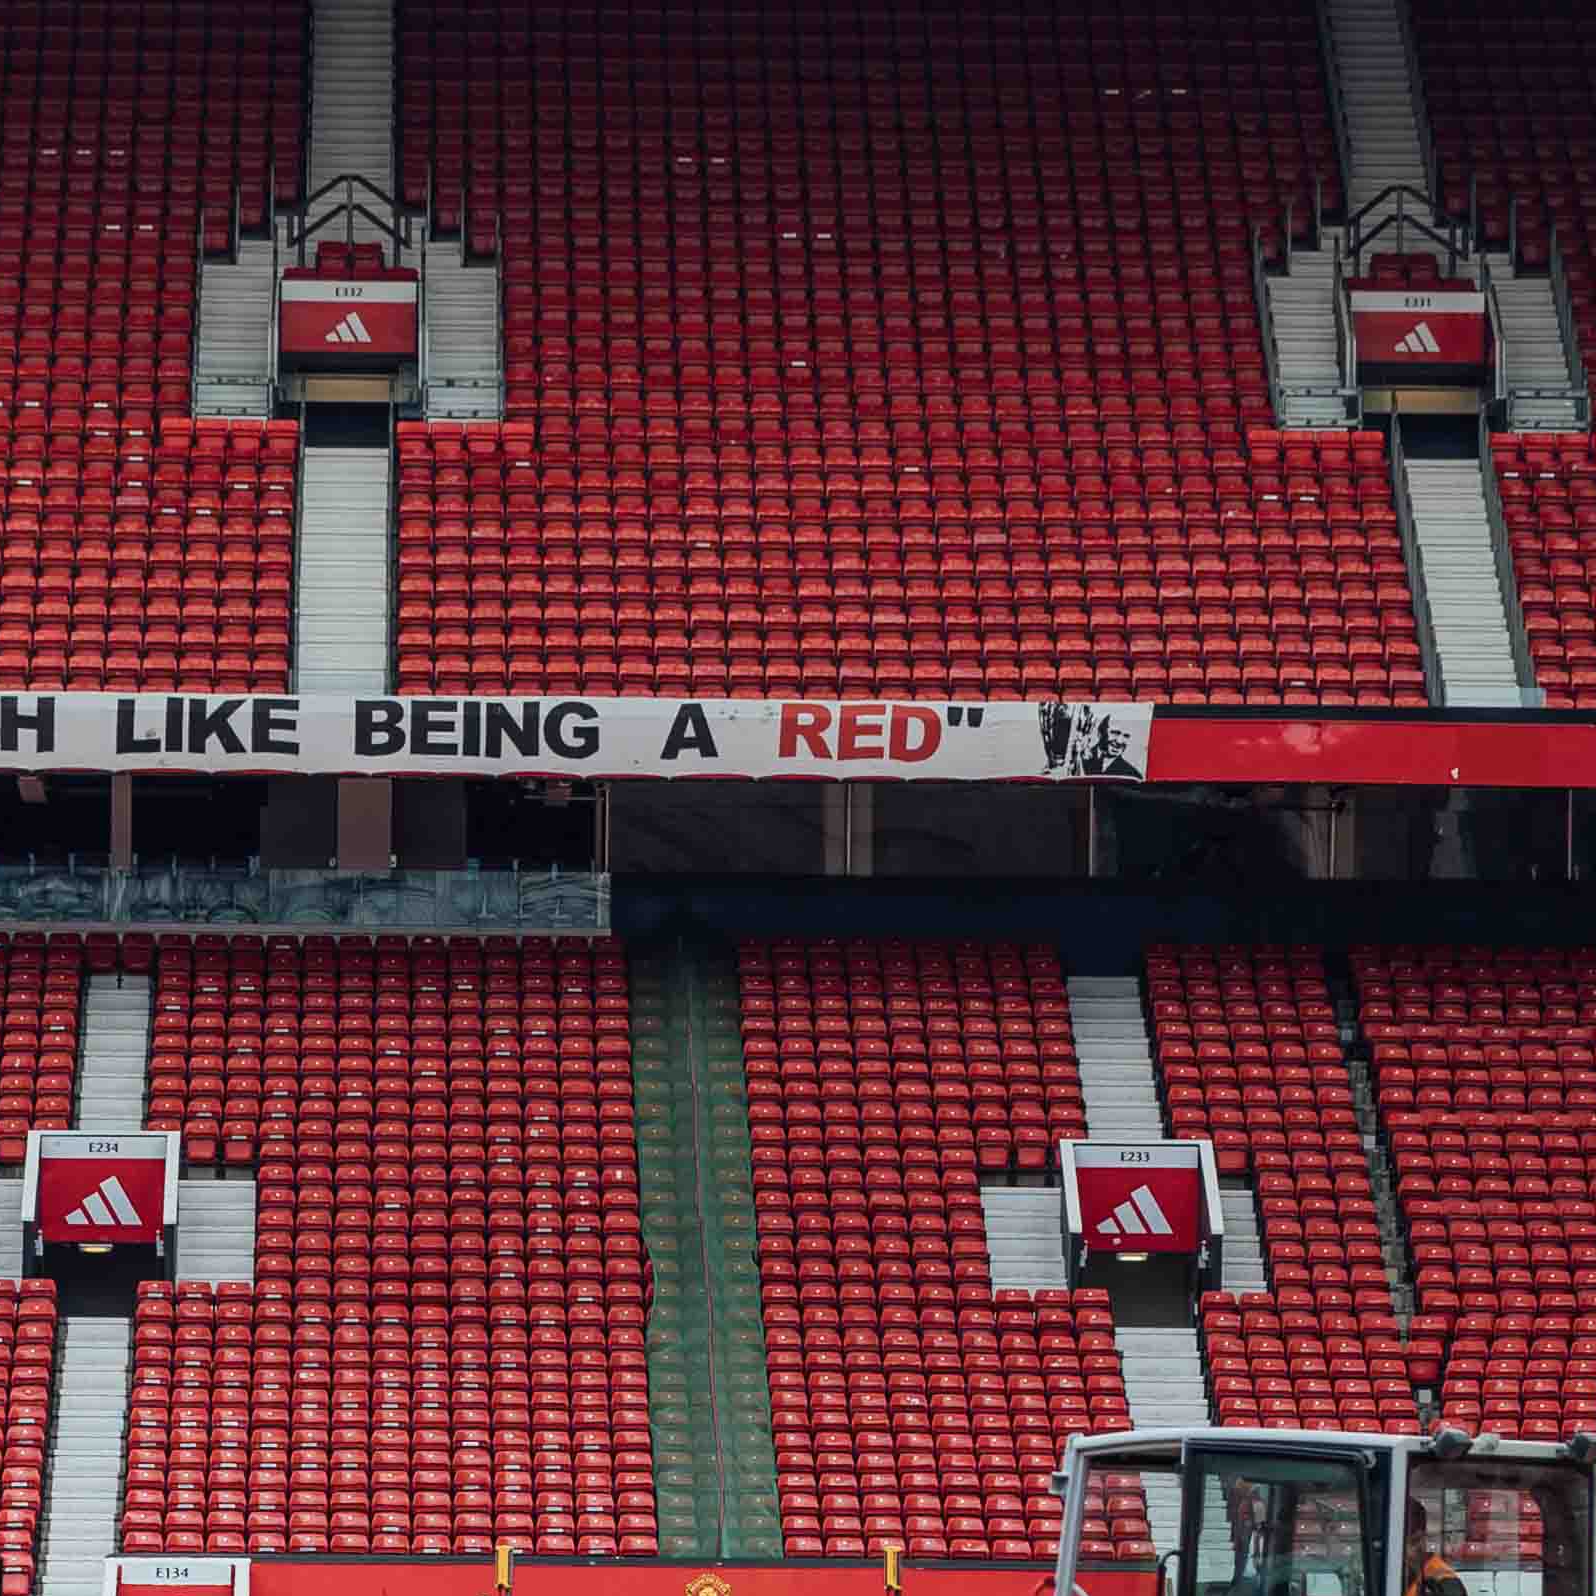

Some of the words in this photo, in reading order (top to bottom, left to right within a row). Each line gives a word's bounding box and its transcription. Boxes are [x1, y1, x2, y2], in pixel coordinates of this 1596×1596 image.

[116, 697, 300, 755] LIKE
[353, 700, 600, 759] BEING
[661, 703, 718, 760] A
[778, 703, 984, 762] RED"
[156, 1567, 189, 1579] E134
